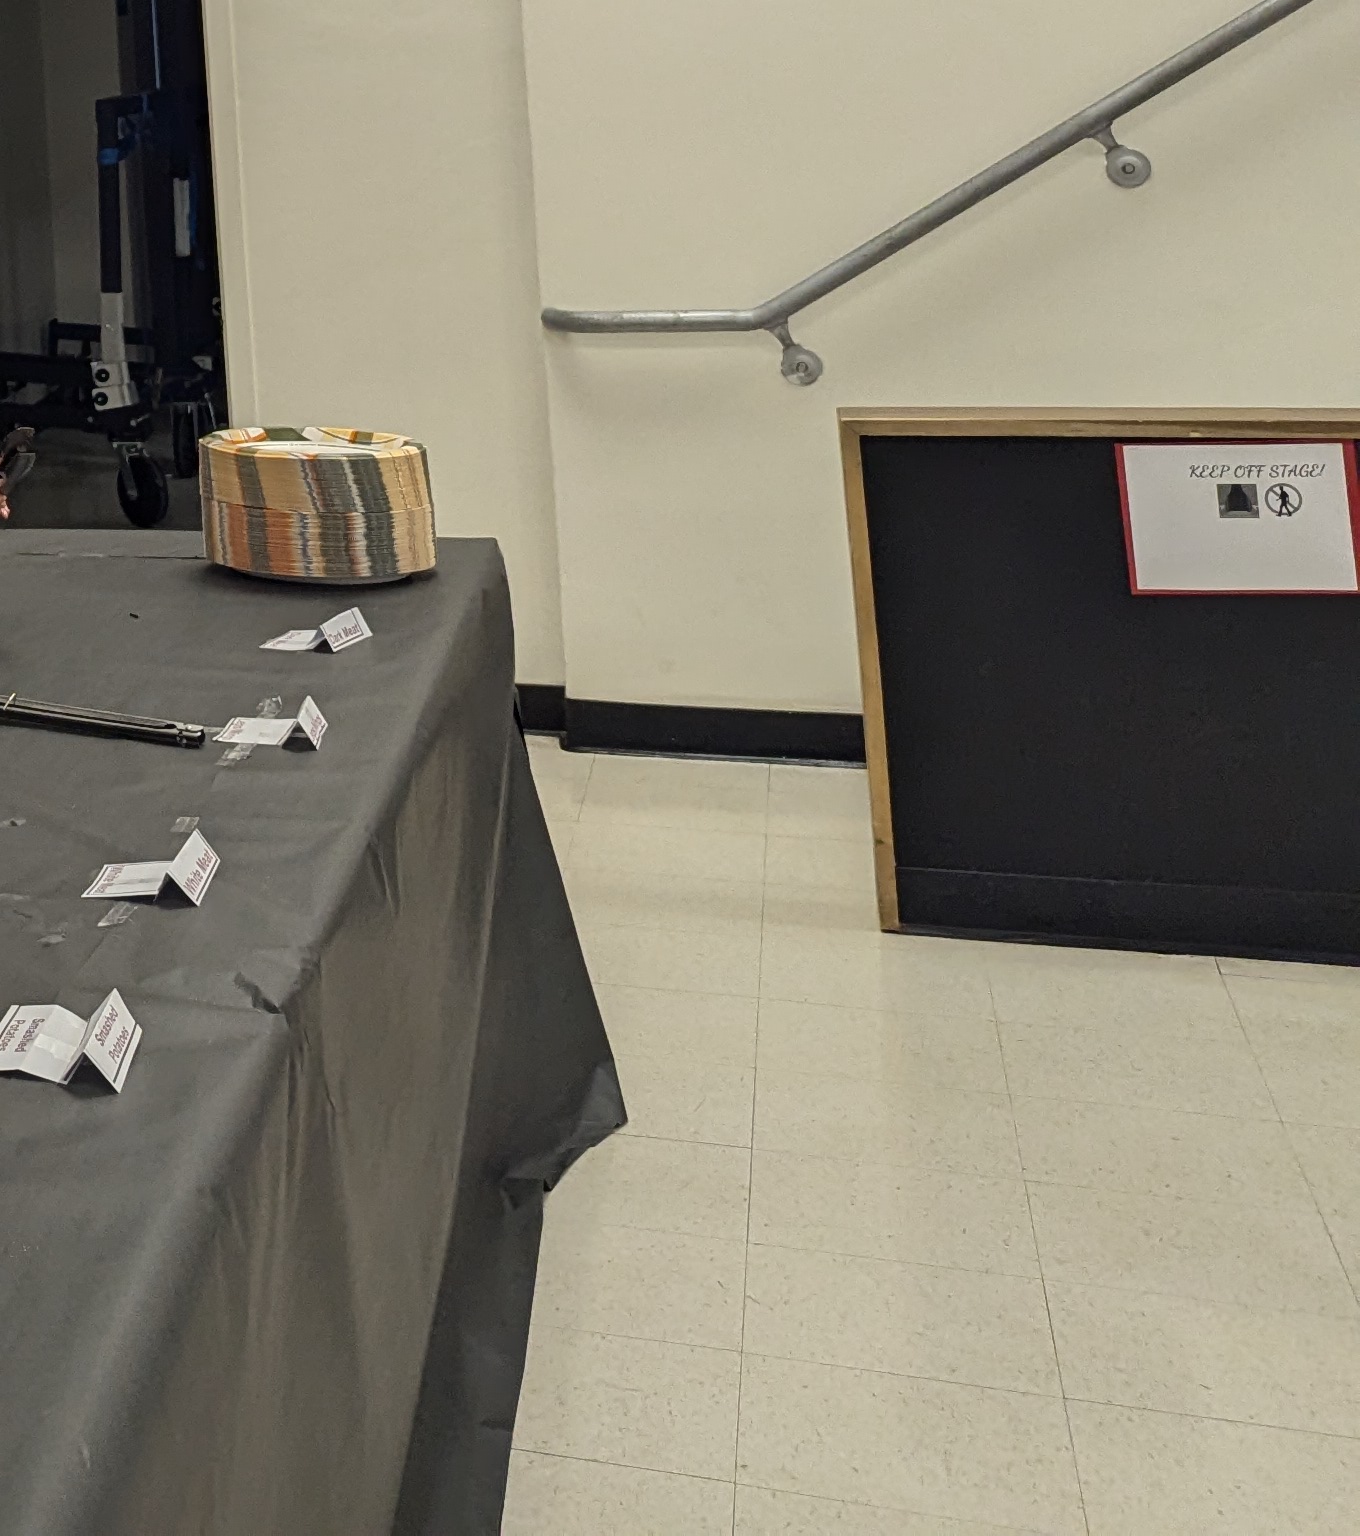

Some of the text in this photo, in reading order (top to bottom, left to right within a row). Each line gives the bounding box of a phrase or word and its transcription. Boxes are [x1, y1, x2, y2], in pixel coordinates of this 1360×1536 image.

[1189, 463, 1326, 479] KEEP OFF STAGE!
[183, 848, 214, 896] White Meat
[108, 1025, 129, 1064] Potatoes
